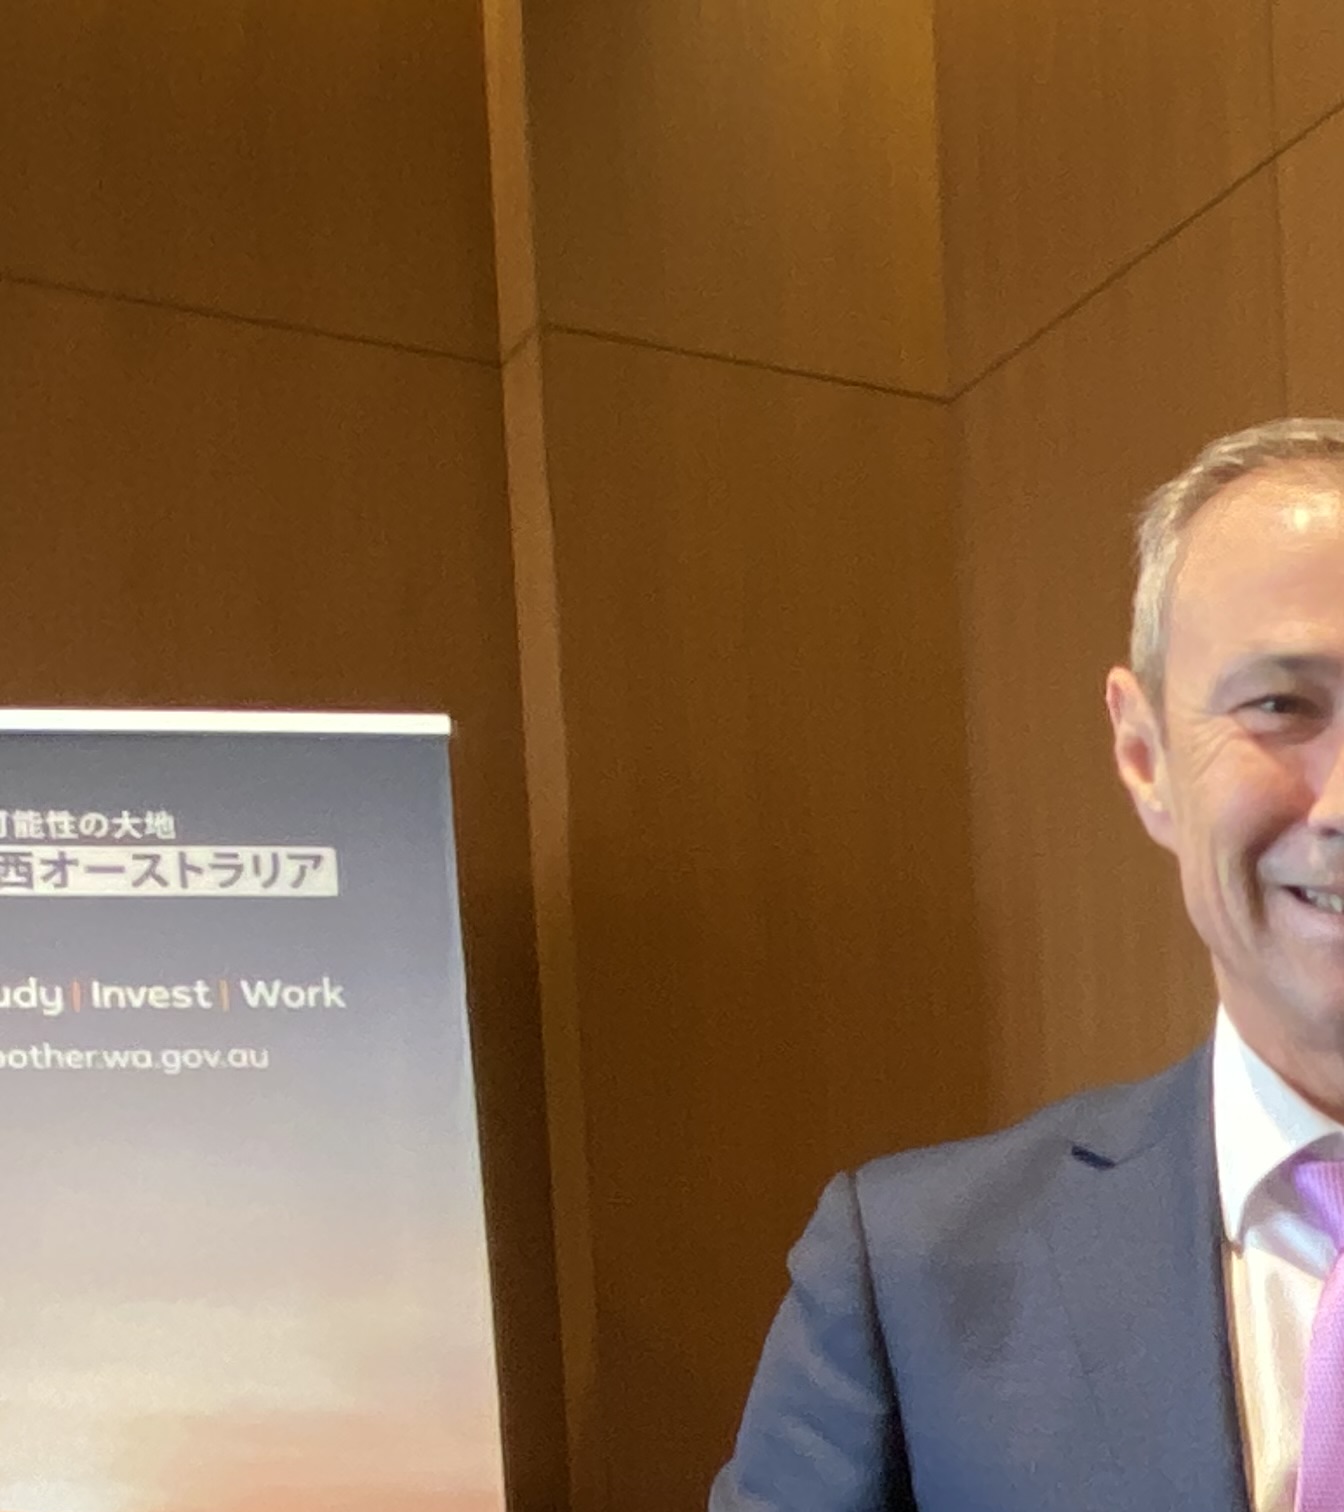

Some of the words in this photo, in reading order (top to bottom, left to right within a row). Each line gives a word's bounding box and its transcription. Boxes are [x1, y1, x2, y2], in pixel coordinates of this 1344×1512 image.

[0, 809, 176, 840] 能性の大地
[0, 850, 323, 889] 西オーストラリア
[92, 980, 213, 1009] Invest
[240, 977, 347, 1009] Work
